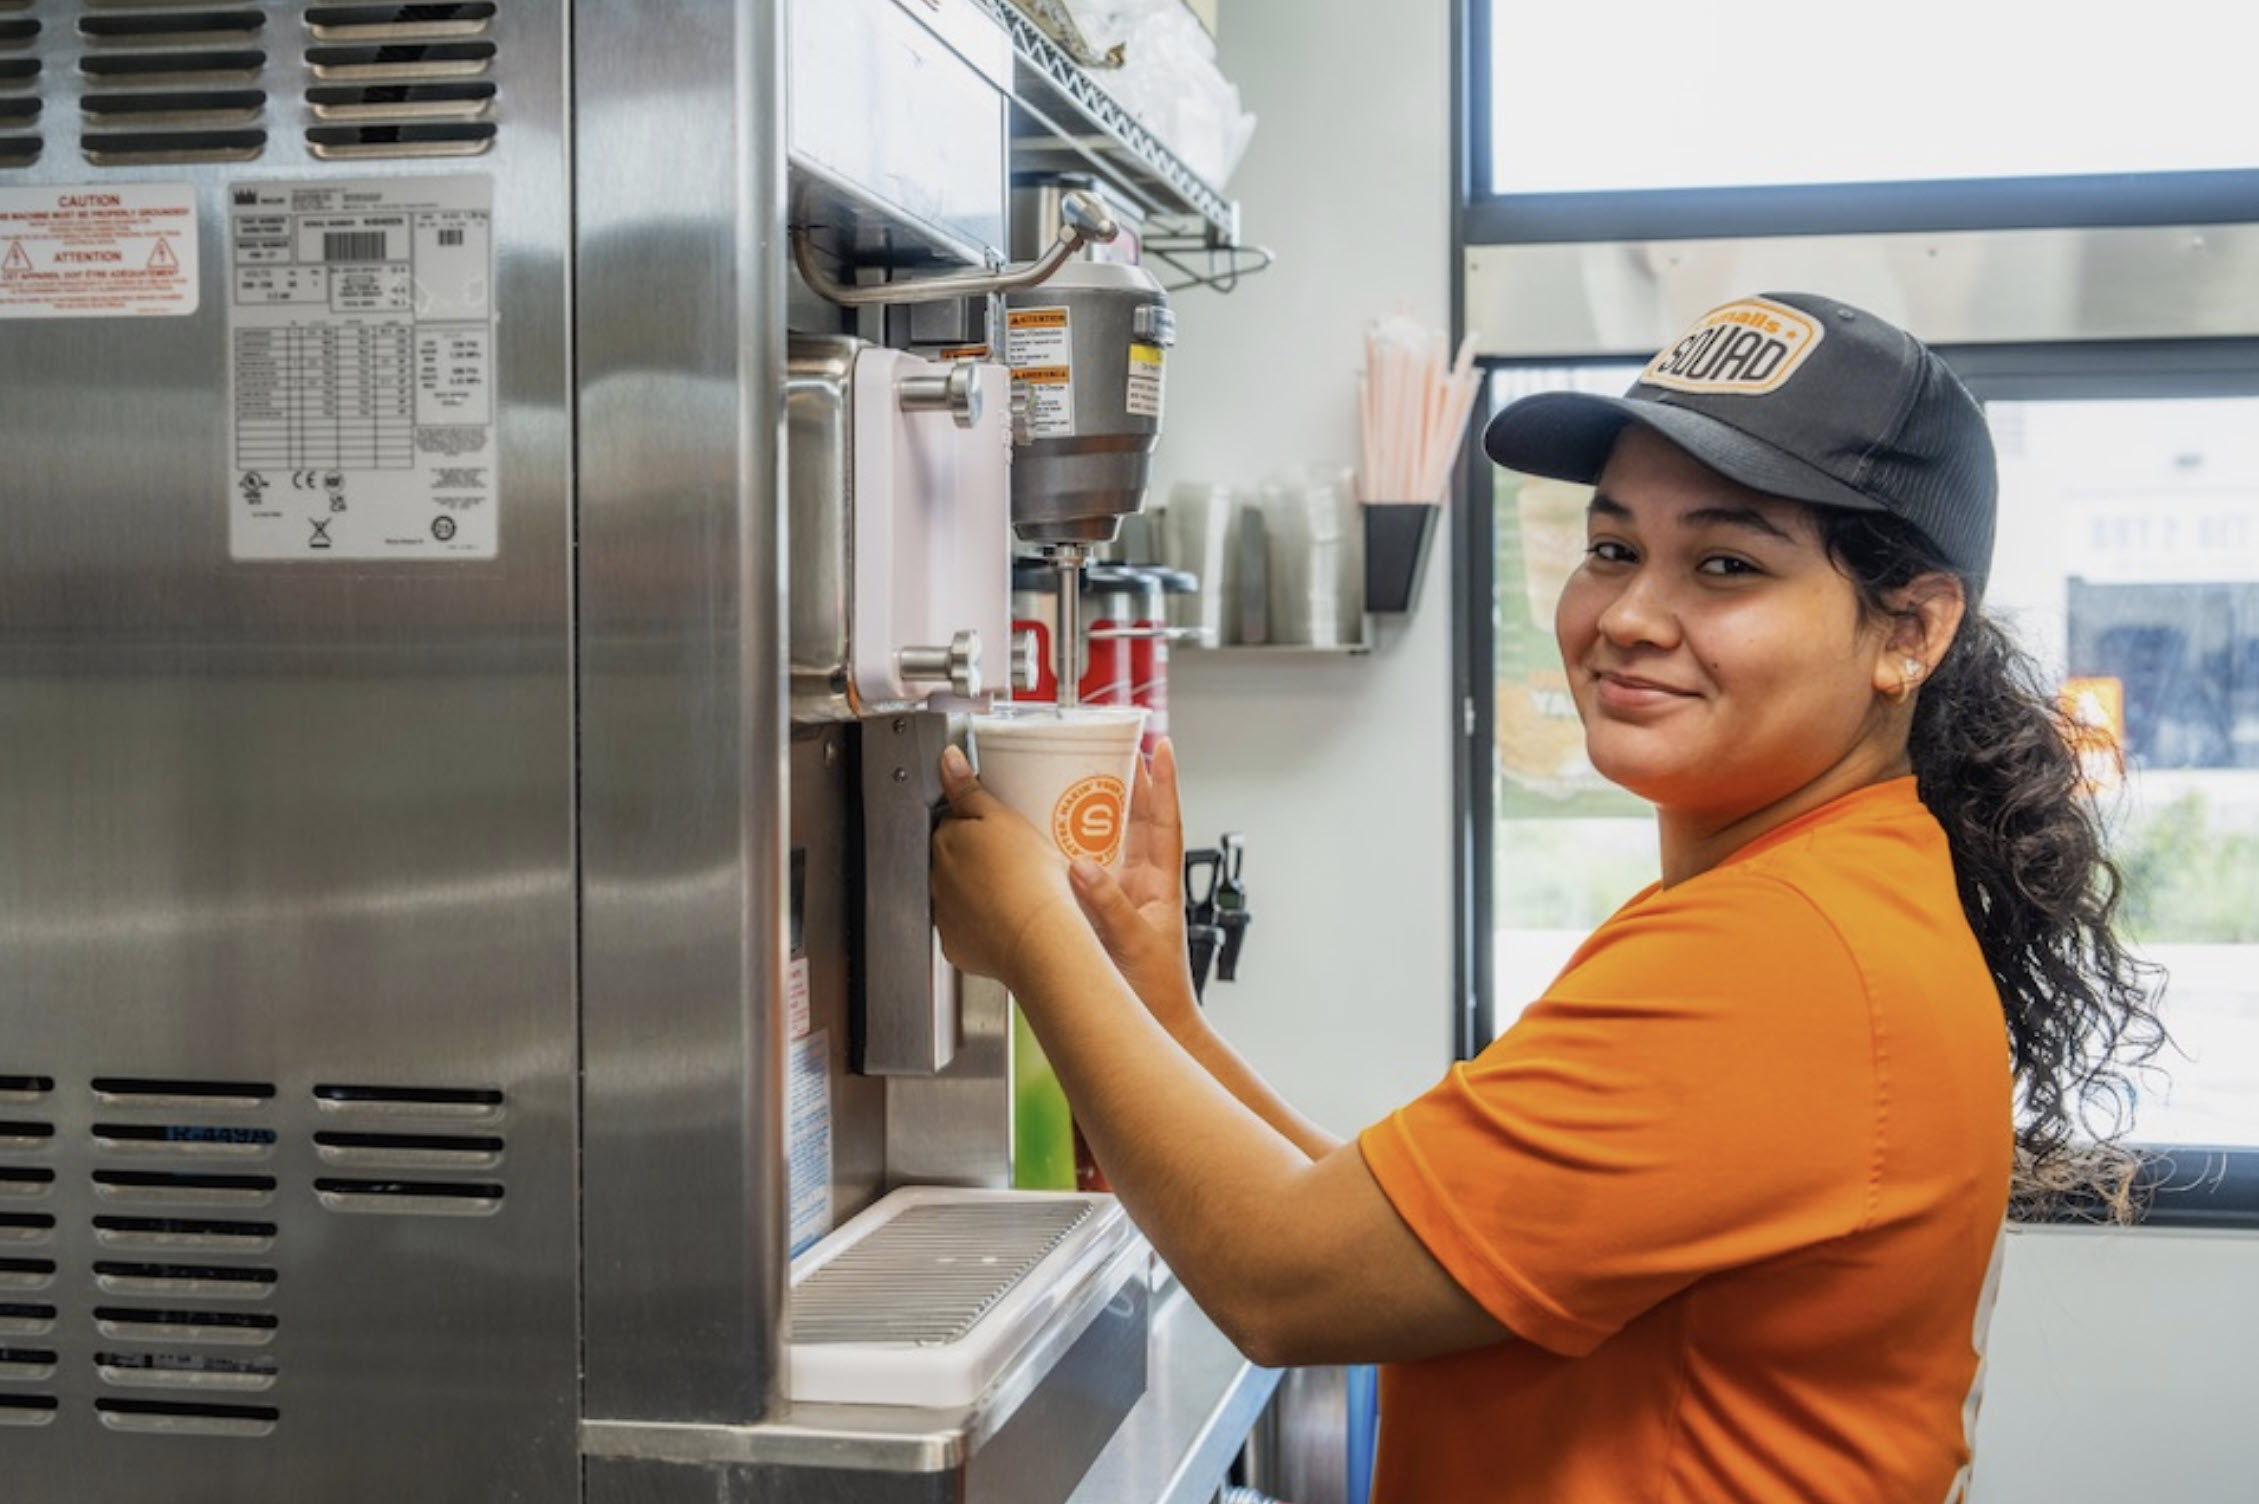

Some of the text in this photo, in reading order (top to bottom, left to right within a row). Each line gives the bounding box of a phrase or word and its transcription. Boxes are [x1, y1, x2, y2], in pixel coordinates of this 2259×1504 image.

[57, 193, 121, 208] CAUTION
[53, 250, 122, 263] ATTENTION
[1657, 325, 1788, 380] SQUAD
[1080, 803, 1113, 837] S
